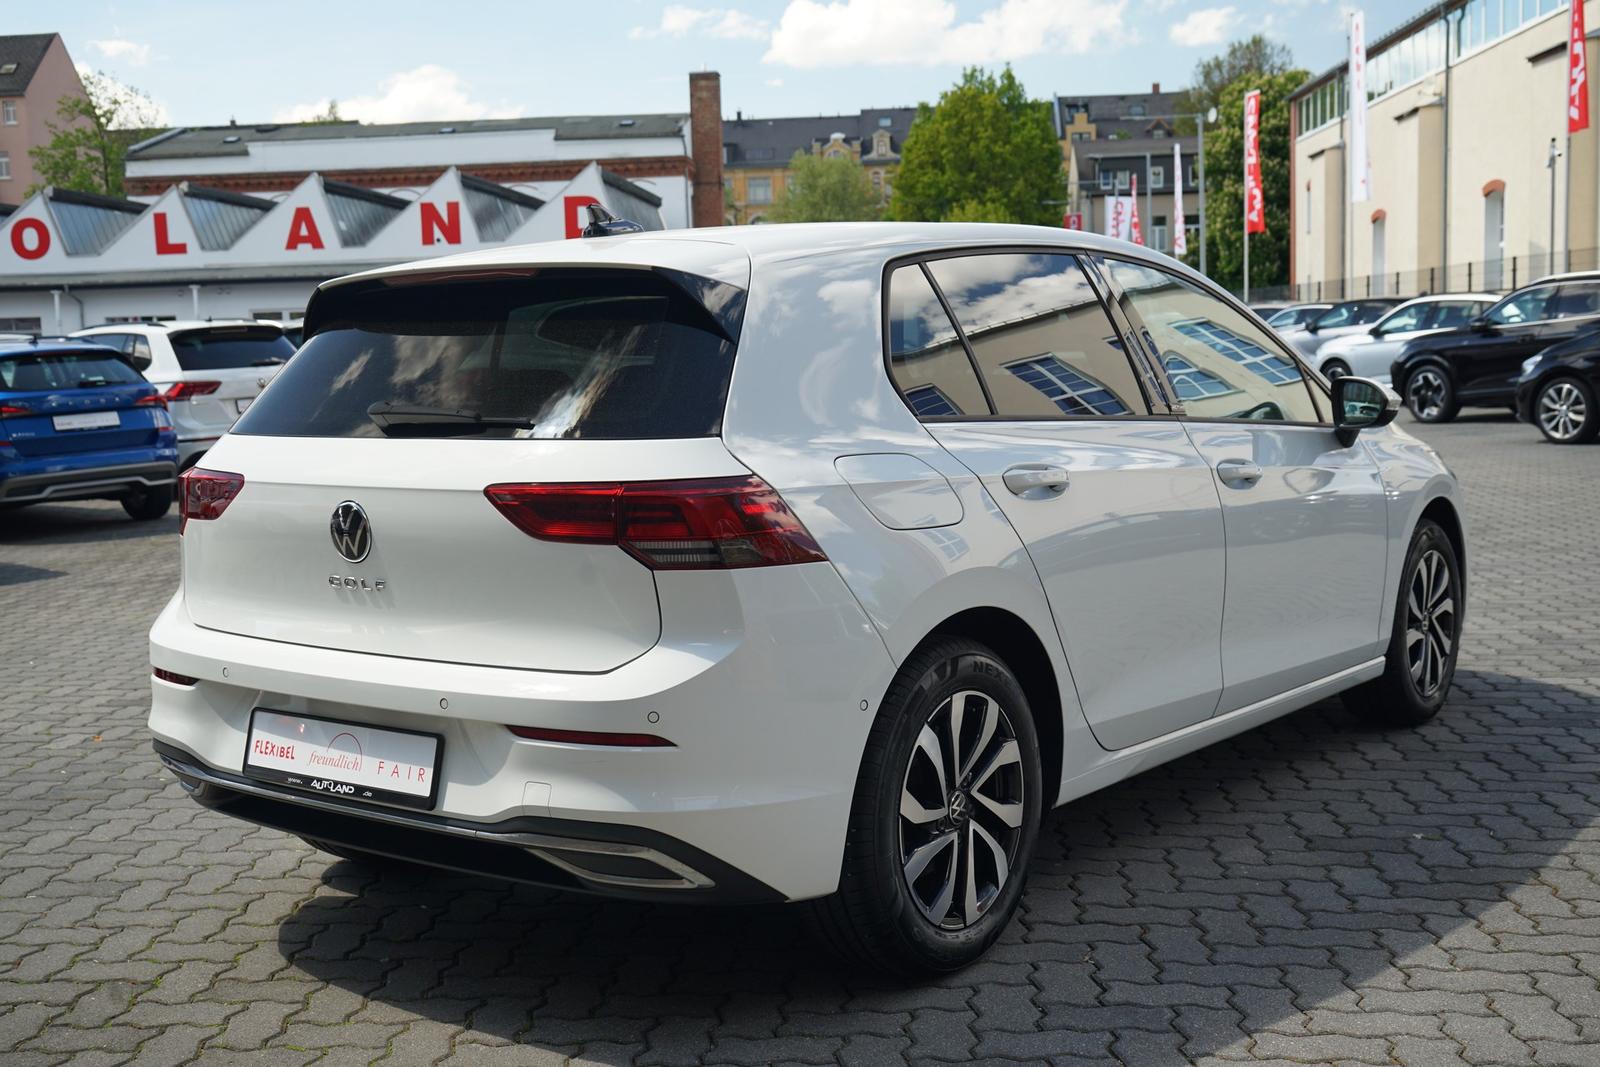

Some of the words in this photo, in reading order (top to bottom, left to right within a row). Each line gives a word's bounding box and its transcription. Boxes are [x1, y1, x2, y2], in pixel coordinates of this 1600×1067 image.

[329, 575, 386, 591] GOLF
[254, 740, 295, 759] FLEXIBEL
[308, 749, 361, 771] freundlich
[311, 779, 354, 794] AUTOLAND
